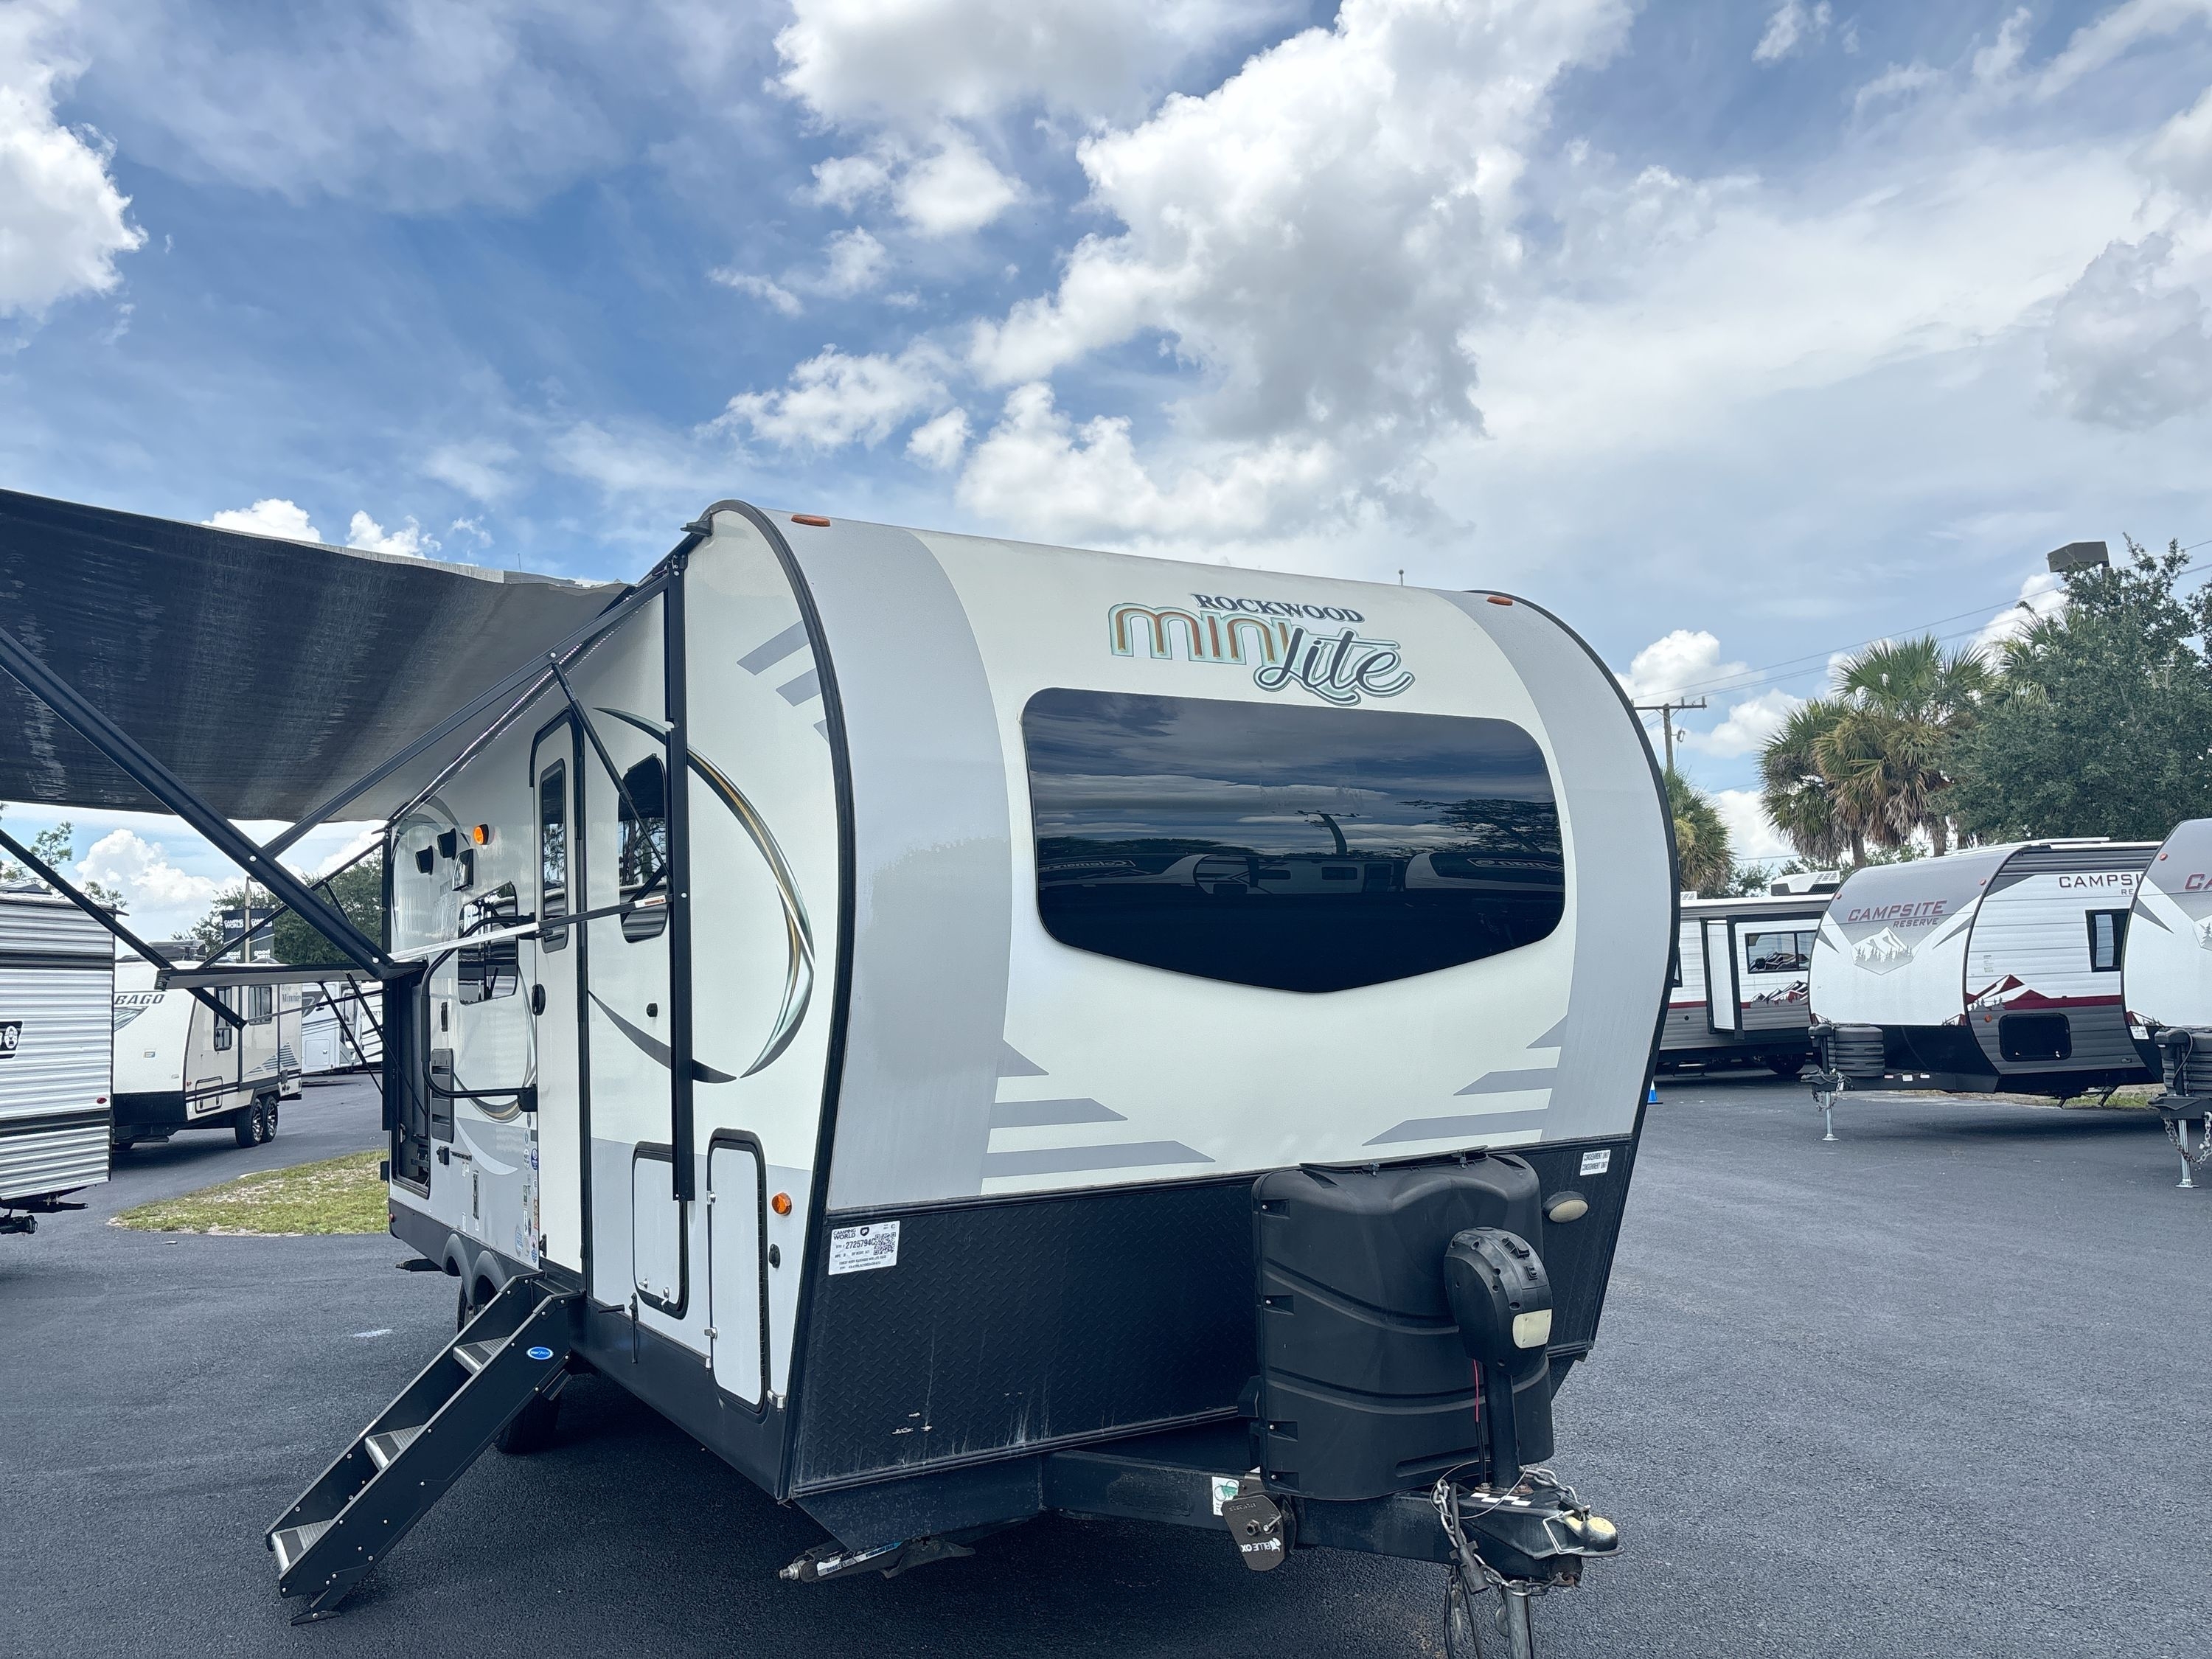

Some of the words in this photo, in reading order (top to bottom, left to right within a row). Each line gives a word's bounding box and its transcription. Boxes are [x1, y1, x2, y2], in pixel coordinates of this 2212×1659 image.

[1193, 594, 1365, 622] ROCKWOOD
[1253, 627, 1415, 706] Lite
[2059, 874, 2141, 888] CAMPSI
[1848, 900, 1948, 922] CAMPSITE
[1893, 918, 1939, 928] RESERVE
[254, 949, 271, 957] good
[1240, 1544, 1253, 1553] OX
[1253, 1542, 1270, 1551] BLUE
